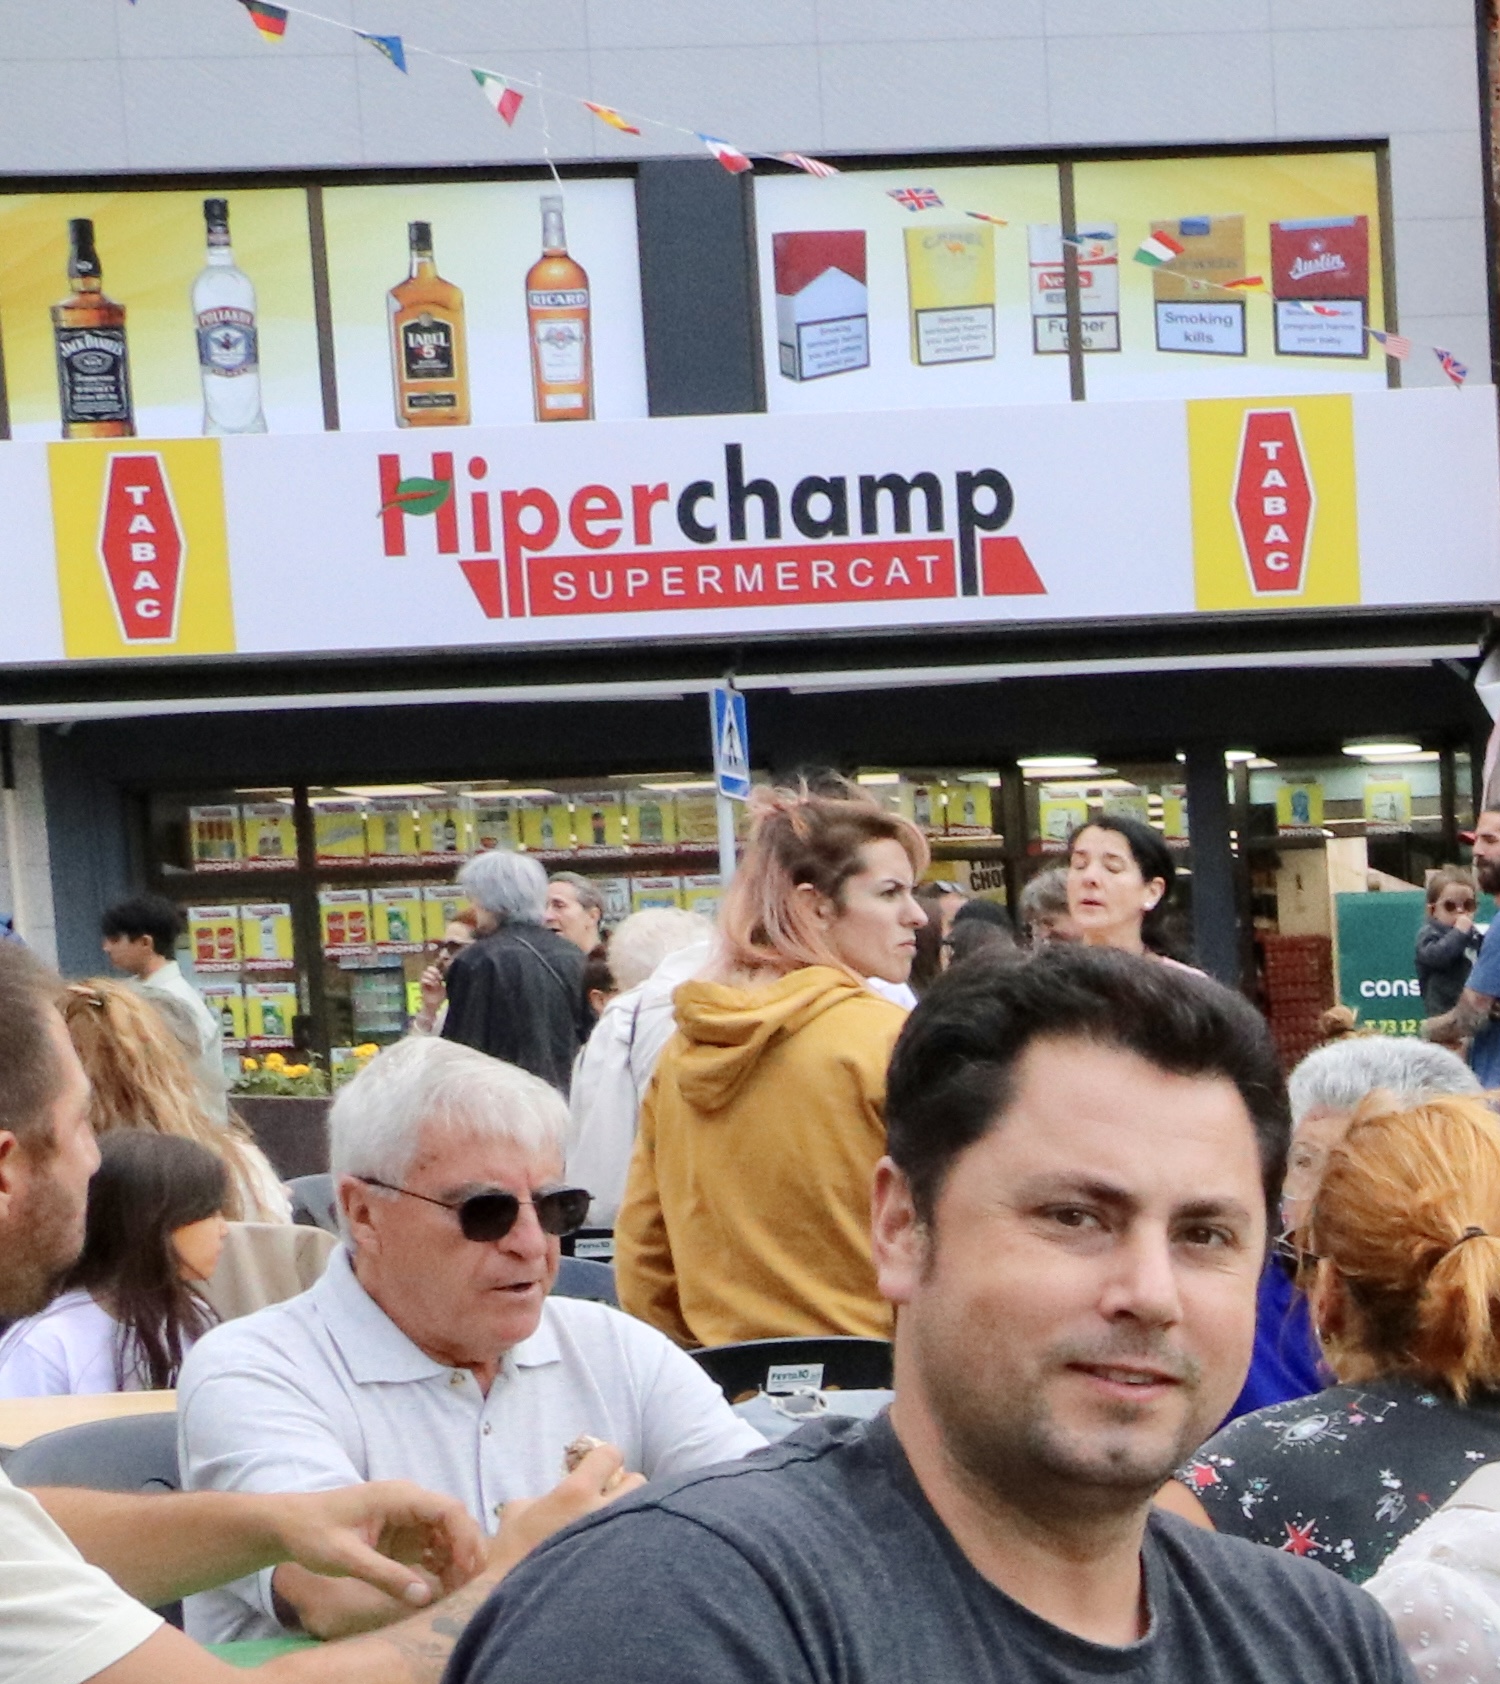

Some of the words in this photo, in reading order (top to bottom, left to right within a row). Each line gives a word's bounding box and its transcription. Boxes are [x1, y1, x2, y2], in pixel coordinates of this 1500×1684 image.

[1289, 253, 1346, 280] Austin
[530, 292, 587, 306] RICARD
[1164, 312, 1234, 328] Smoking
[407, 332, 450, 349] LABEL
[1184, 330, 1214, 345] kills
[1259, 441, 1291, 571] TABAC
[378, 443, 1016, 619] Hiperchamp
[125, 485, 161, 618] TABAC
[552, 555, 942, 601] SUPERMERCAT
[1380, 1019, 1396, 1033] 73
[1401, 1019, 1417, 1033] 12
